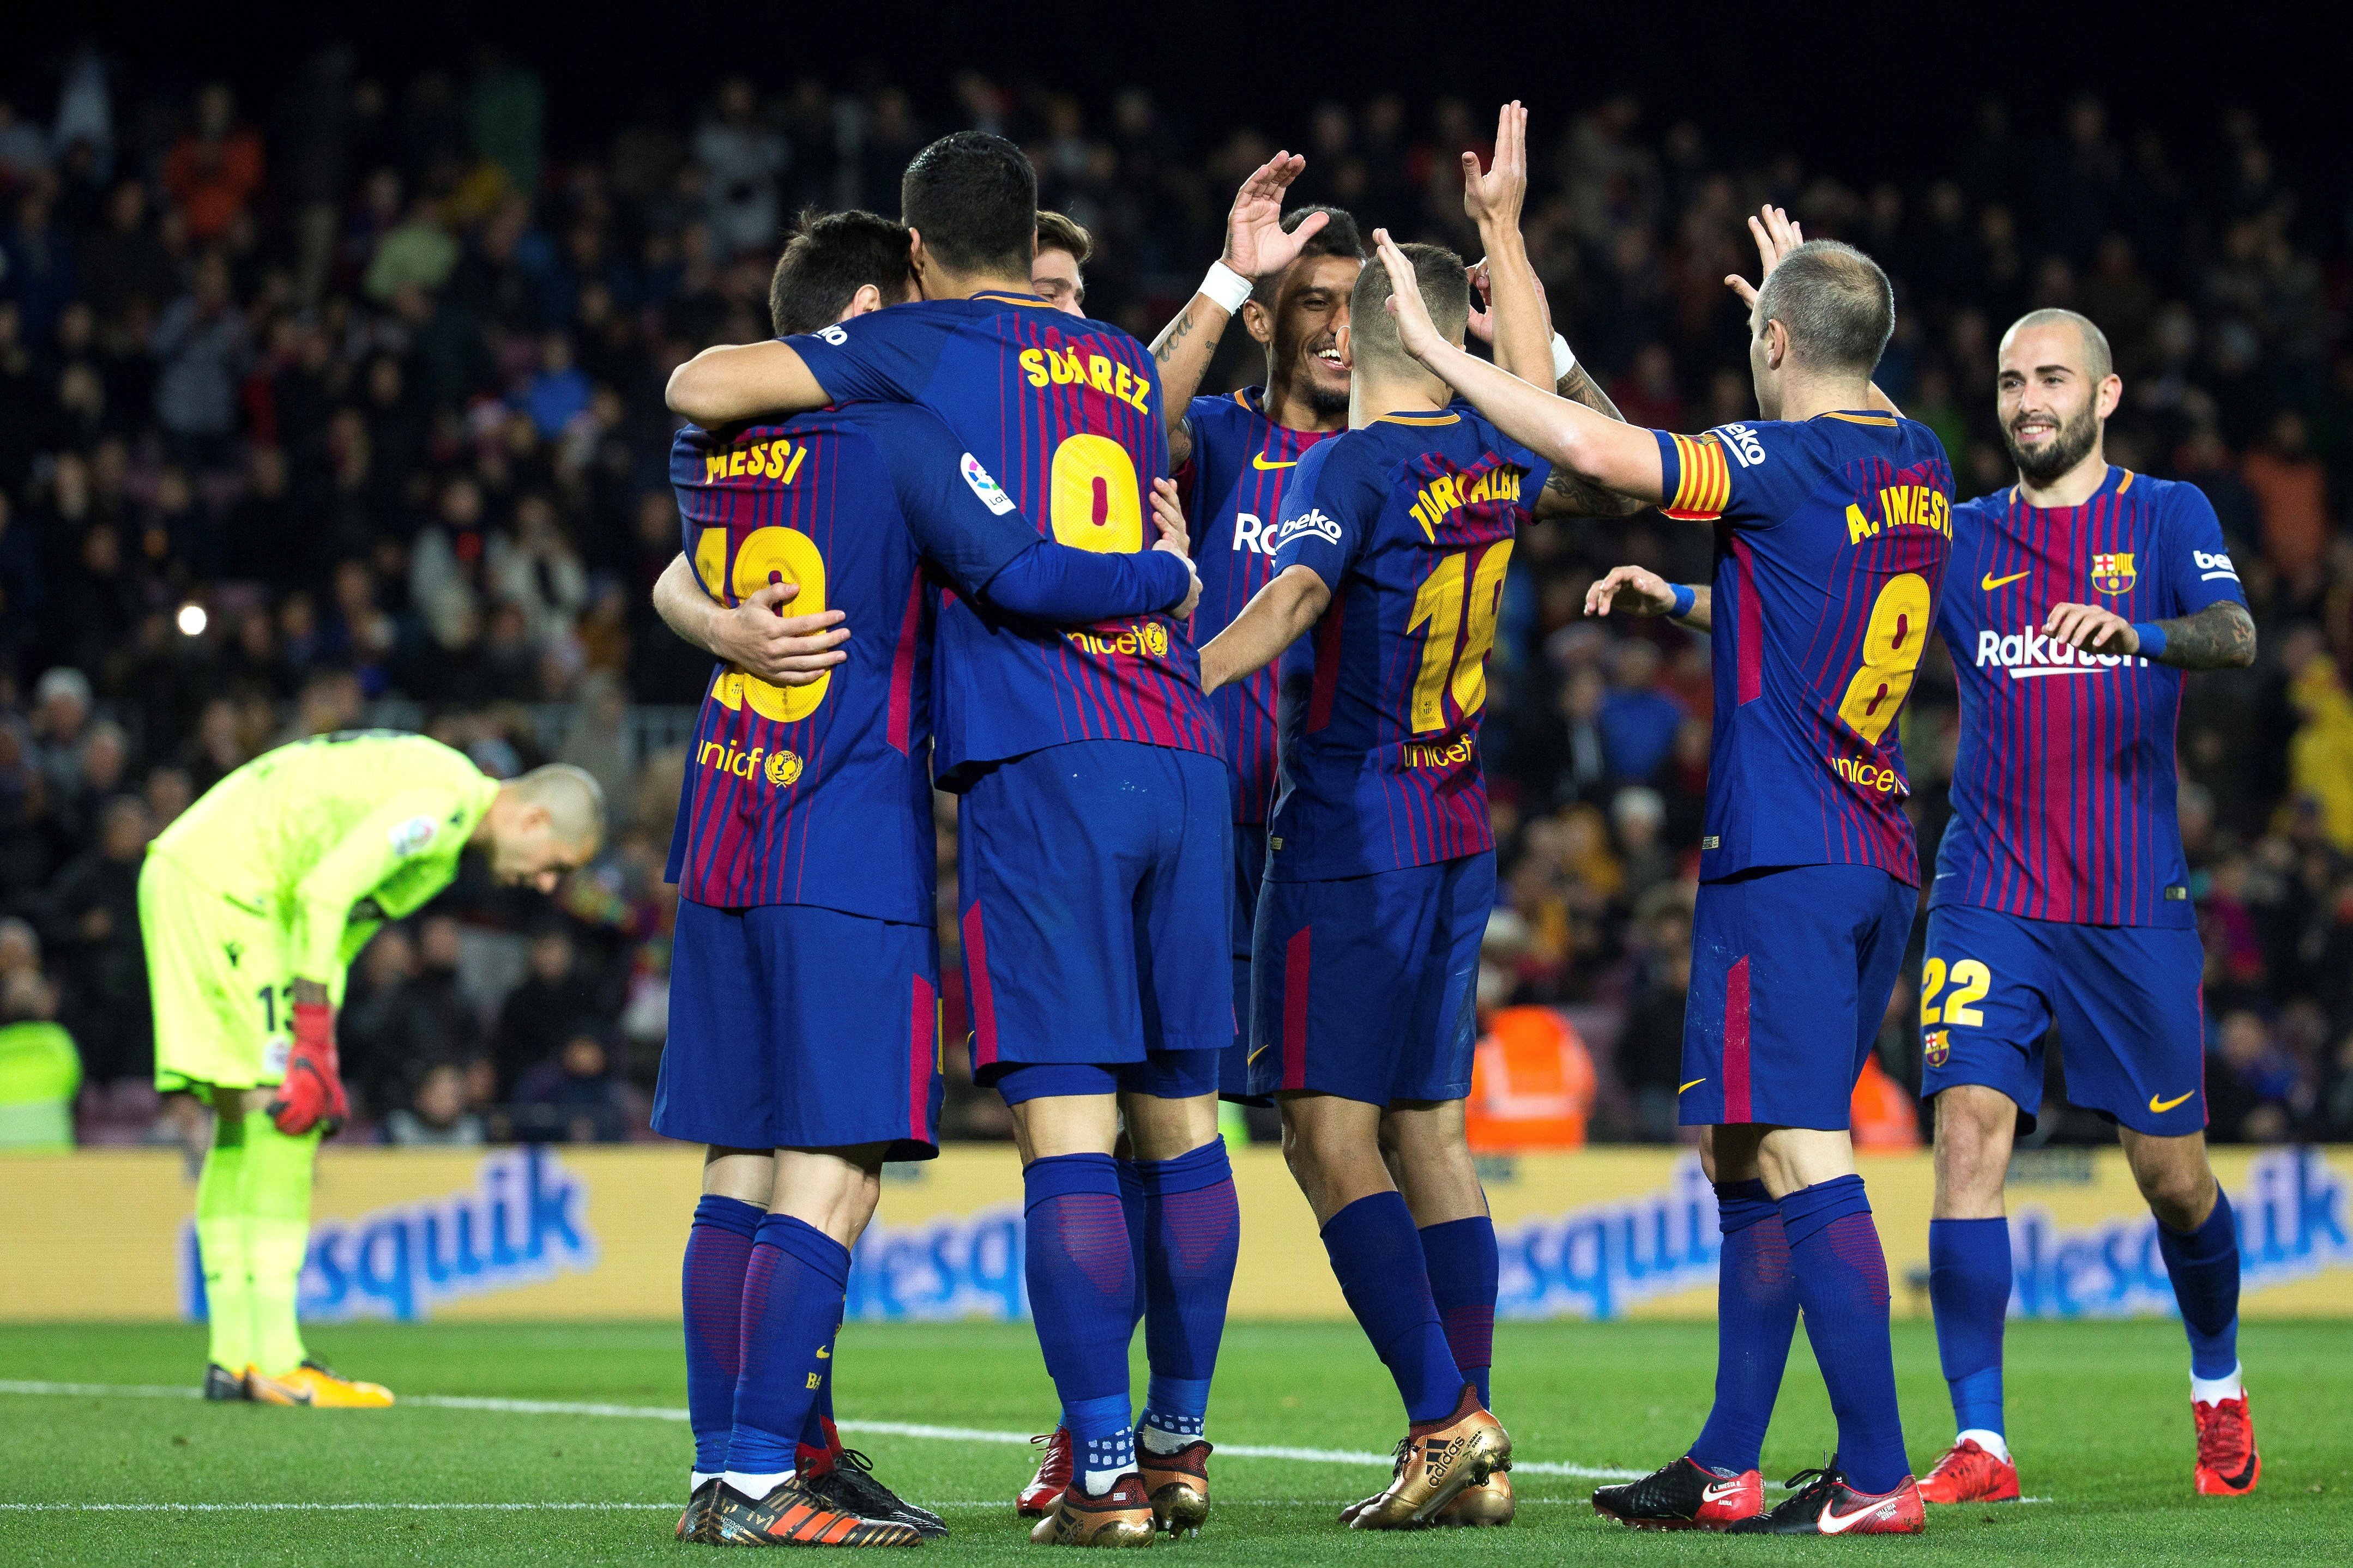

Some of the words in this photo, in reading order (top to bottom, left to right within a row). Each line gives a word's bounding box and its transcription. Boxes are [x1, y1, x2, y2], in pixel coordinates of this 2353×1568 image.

[1019, 346, 1150, 415] SUÁREZ
[705, 437, 807, 486] MESSI
[1718, 423, 1766, 465] eko
[1279, 508, 1342, 538] beko
[1845, 503, 1880, 545] A.
[1880, 485, 1953, 542] INIEST
[2193, 550, 2235, 572] be
[695, 526, 831, 723] 10
[1066, 625, 1147, 656] nicef
[1406, 538, 1515, 734] 18
[1837, 573, 1930, 746] 8
[1403, 732, 1473, 767] unicef
[1921, 957, 1991, 1028] 22
[1472, 1435, 1483, 1449] DAVID
[1428, 1436, 1465, 1488] adidas
[1717, 1481, 1736, 1490] INIESTA
[720, 1515, 745, 1533] THIAGO
[1875, 1503, 1897, 1518] VALERIA
[1881, 1508, 1897, 1522] SIENA
